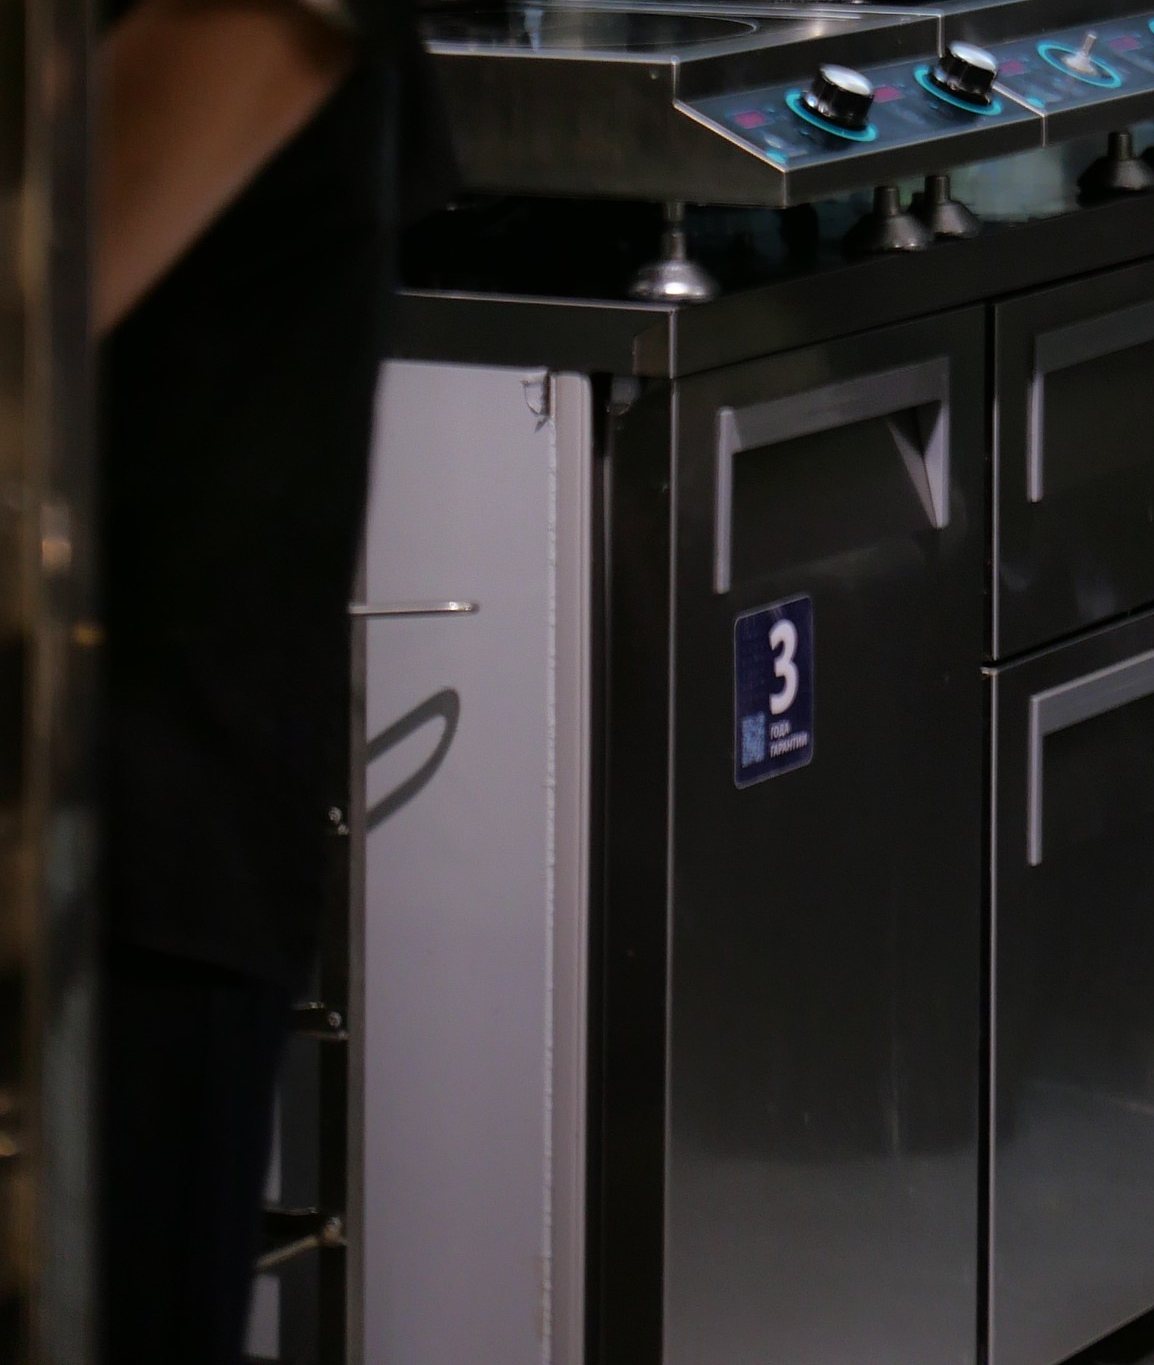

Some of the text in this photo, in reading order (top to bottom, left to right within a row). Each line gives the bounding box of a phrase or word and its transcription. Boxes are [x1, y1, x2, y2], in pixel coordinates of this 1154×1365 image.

[768, 618, 799, 715] 3
[769, 719, 791, 741] ГОДА
[769, 731, 808, 758] ГАРАНТИИ
